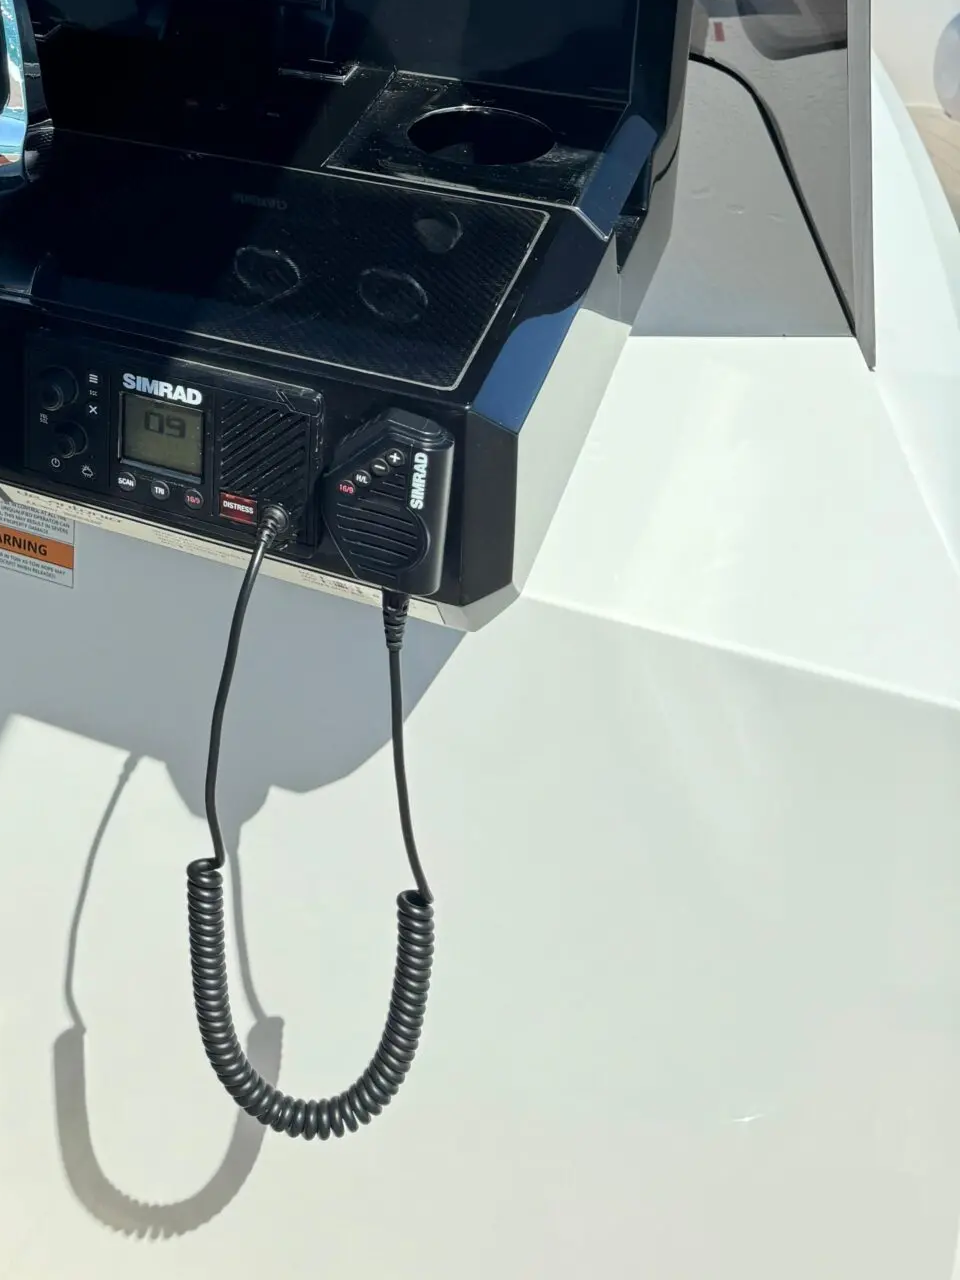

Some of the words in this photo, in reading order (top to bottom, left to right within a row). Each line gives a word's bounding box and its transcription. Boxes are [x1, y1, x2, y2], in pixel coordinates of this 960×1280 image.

[122, 373, 203, 406] SIMRAD
[144, 411, 186, 439] 09
[117, 477, 134, 487] SCAN
[355, 474, 369, 485] H/L
[410, 451, 429, 510] SIMRAD
[153, 486, 165, 496] TRI
[338, 484, 354, 494] 16/9
[185, 494, 201, 505] 16/9
[223, 500, 254, 515] DISTRESS
[34, 513, 59, 525] OPERATOR
[27, 518, 44, 526] RESULT
[52, 524, 68, 534] SEVERE
